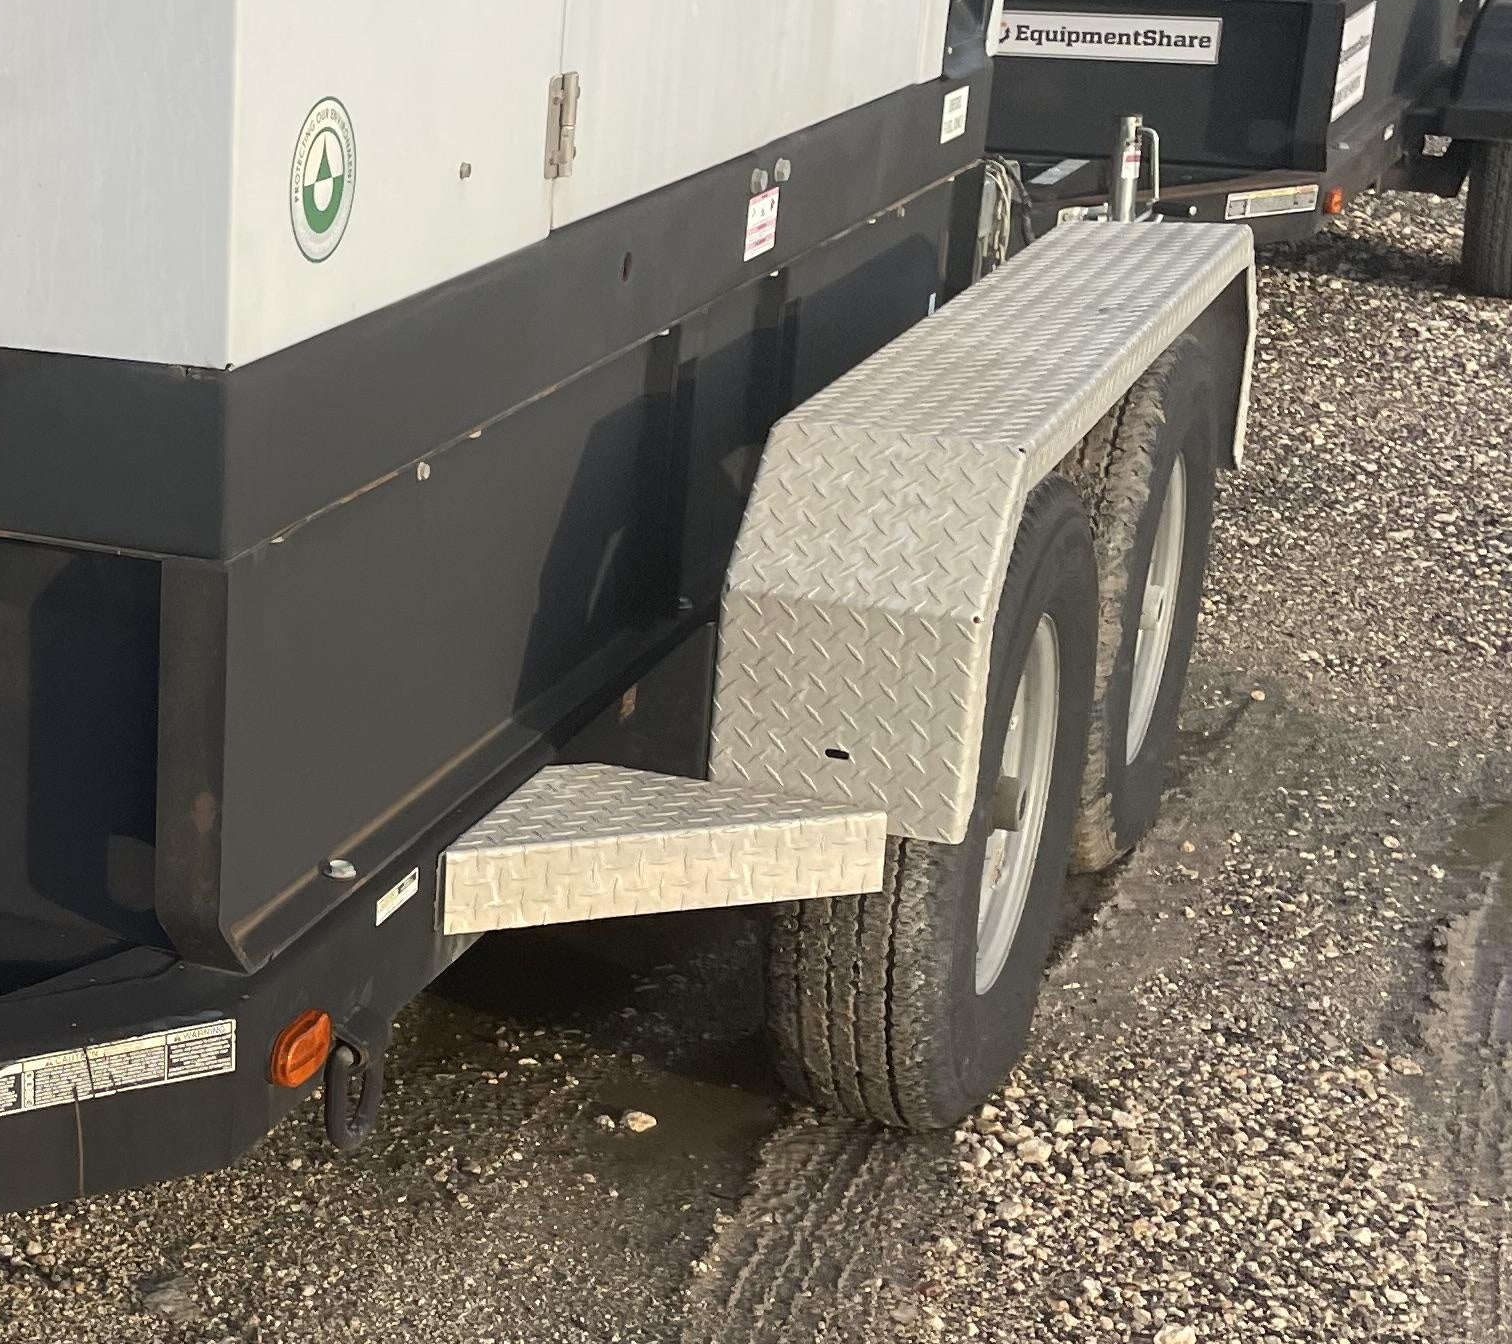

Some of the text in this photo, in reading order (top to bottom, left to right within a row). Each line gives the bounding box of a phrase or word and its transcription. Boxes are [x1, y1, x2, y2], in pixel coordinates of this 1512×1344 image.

[1014, 24, 1212, 49] EquipmentShare
[294, 119, 316, 203] PROTECTING
[183, 1025, 226, 1041] WARNING
